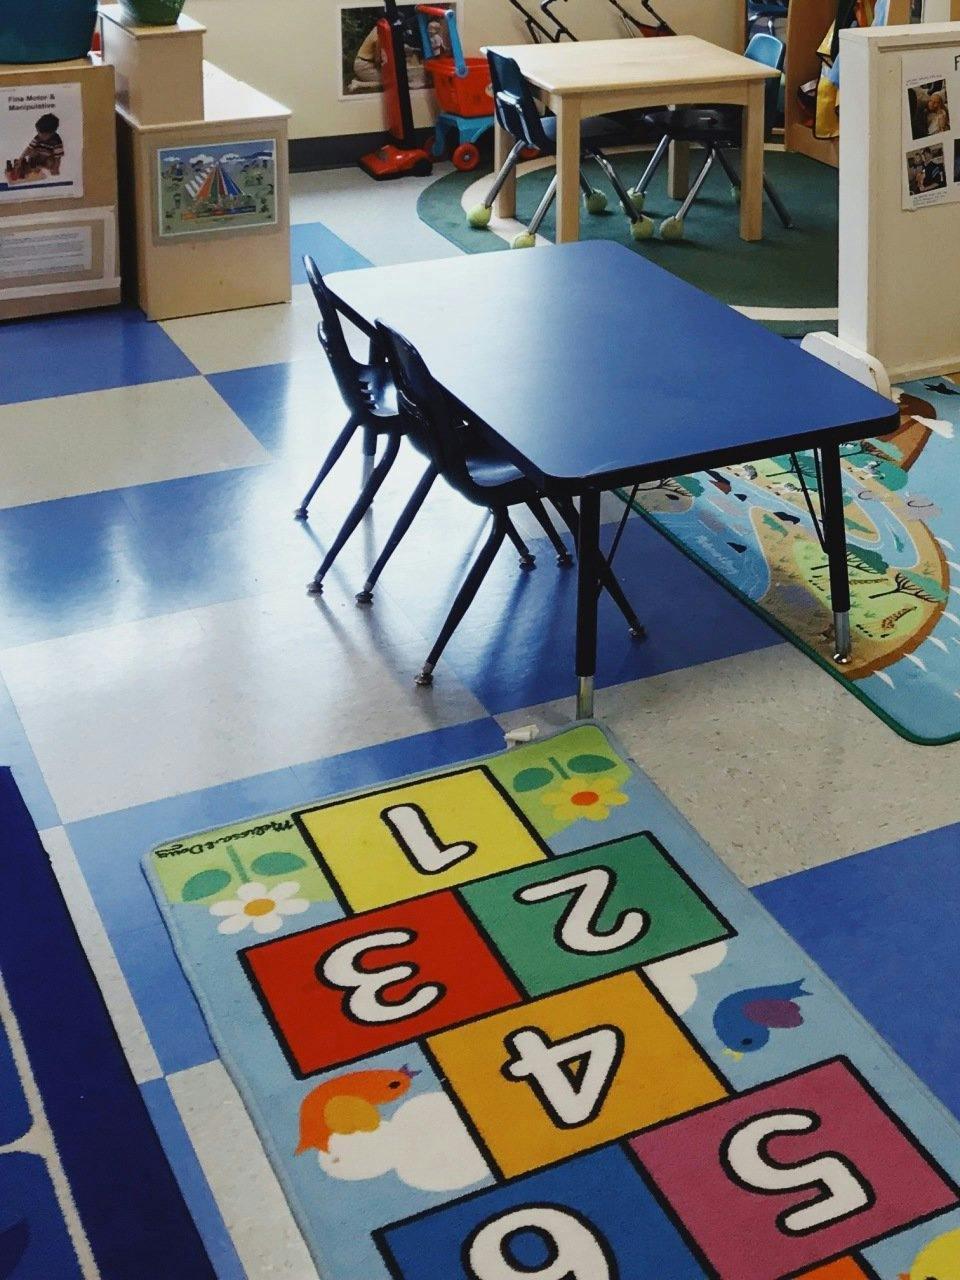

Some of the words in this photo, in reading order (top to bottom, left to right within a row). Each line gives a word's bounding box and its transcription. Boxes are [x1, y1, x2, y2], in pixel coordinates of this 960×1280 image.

[9, 103, 55, 111] Manipulative
[155, 843, 203, 859] Doug
[218, 821, 293, 844] Melissa
[380, 803, 477, 874] 1
[513, 865, 651, 955] 2
[315, 929, 446, 1026] 3
[500, 1024, 624, 1129] 4
[720, 1109, 876, 1236] 5
